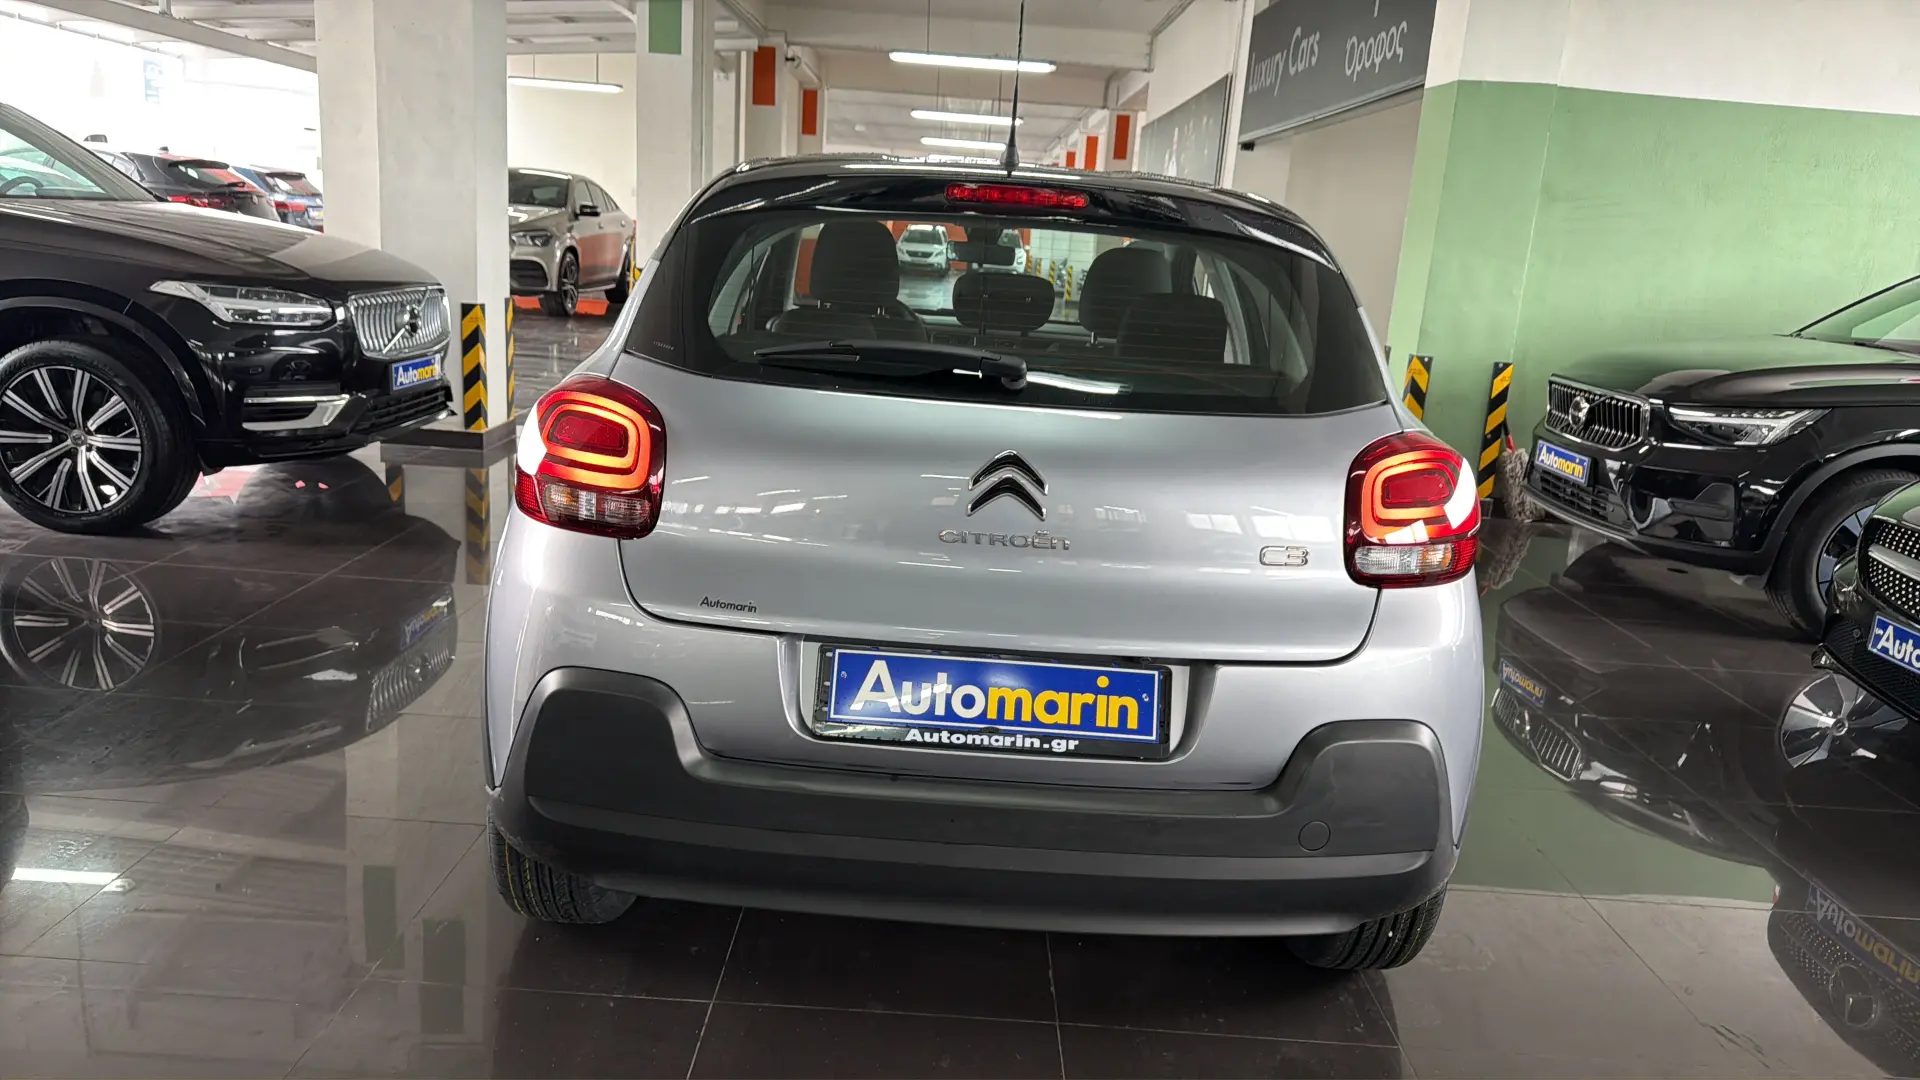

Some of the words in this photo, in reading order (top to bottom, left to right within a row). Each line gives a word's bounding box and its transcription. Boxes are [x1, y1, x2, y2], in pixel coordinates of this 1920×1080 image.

[1248, 50, 1287, 97] Luxury
[1288, 25, 1320, 76] Cars
[1539, 443, 1584, 478] Automarin
[1259, 545, 1309, 567] C3
[699, 595, 757, 613] Automarin
[850, 659, 1139, 730] Automarin
[903, 728, 1080, 752] Automarin.gr
